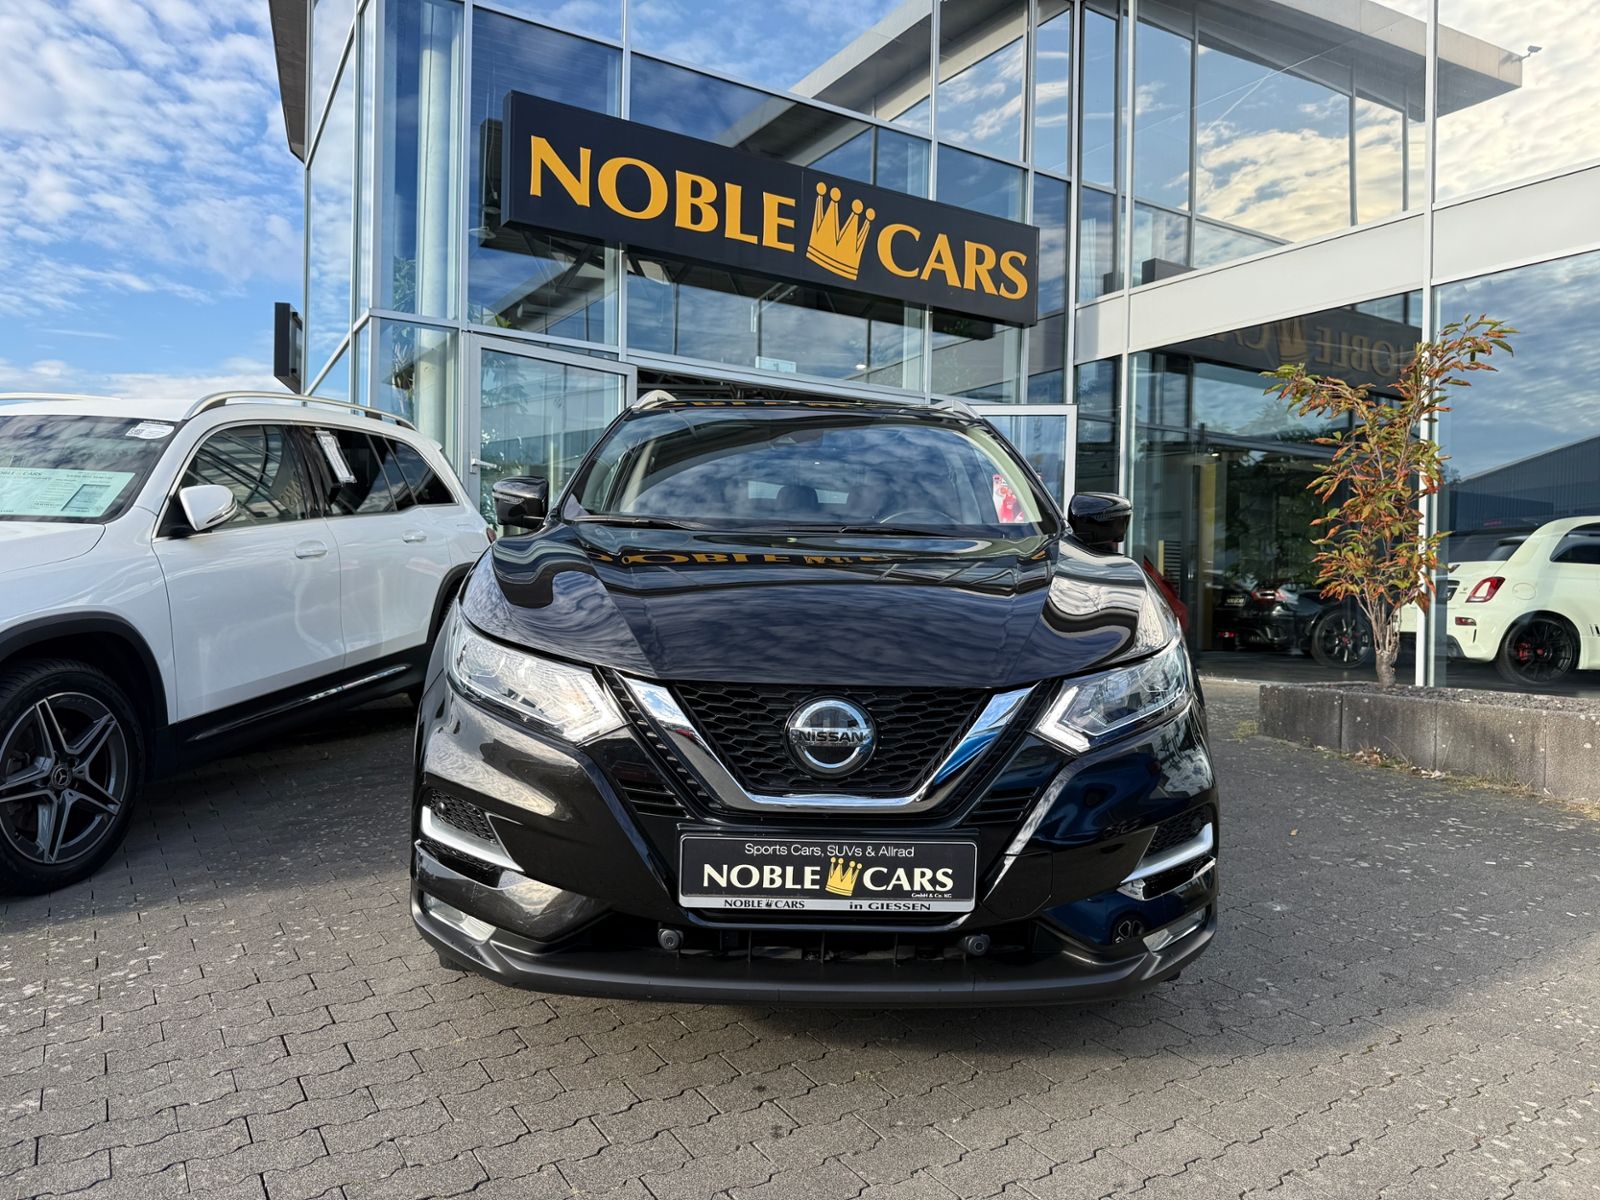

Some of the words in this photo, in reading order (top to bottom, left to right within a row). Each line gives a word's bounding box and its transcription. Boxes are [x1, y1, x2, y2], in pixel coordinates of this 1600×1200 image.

[528, 134, 796, 254] NOBLE
[876, 223, 1030, 300] CARS
[800, 731, 864, 742] NISSAN
[744, 842, 788, 856] Sports
[791, 844, 825, 857] Cars,
[826, 845, 862, 856] SUVs
[865, 845, 875, 857] &
[878, 845, 915, 857] Allrad
[703, 863, 821, 889] NOBLE
[862, 867, 954, 892] CARS
[724, 899, 763, 908] NOBLE
[774, 900, 806, 909] CARS
[849, 901, 863, 910] in
[867, 902, 931, 911] GIESSEN
